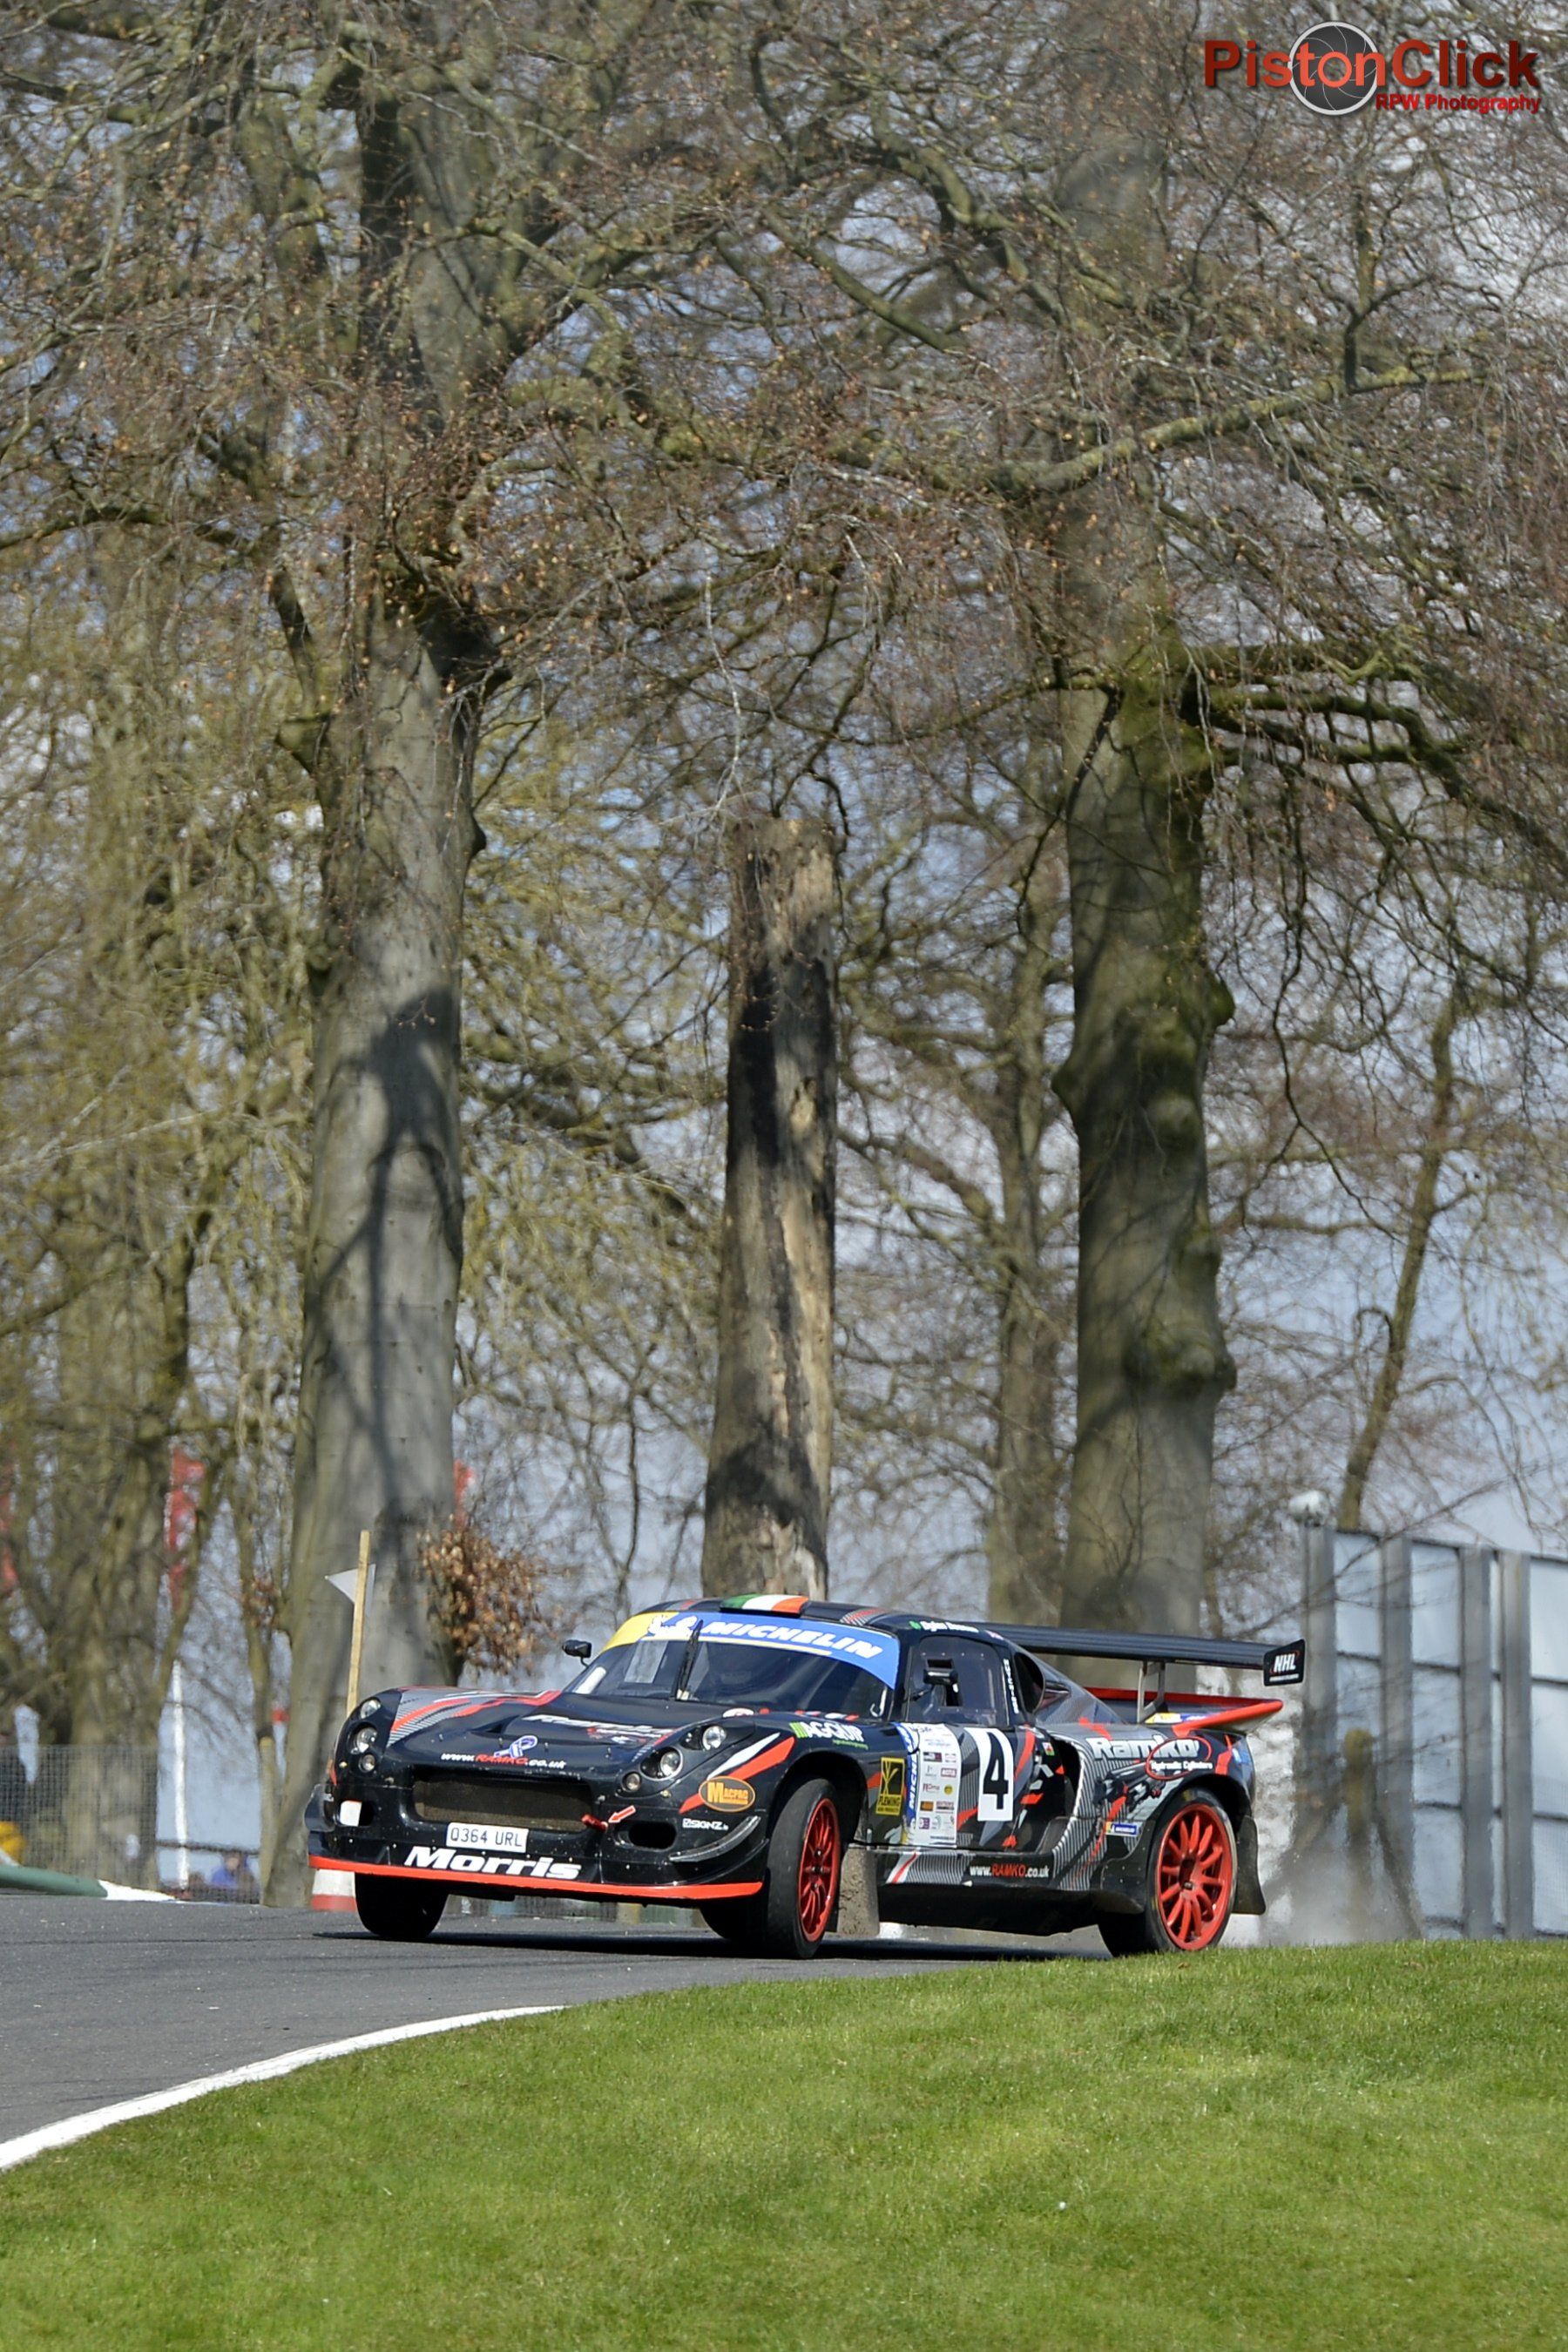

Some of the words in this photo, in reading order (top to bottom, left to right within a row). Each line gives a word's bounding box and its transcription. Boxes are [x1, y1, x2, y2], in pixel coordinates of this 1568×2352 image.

[700, 1621, 883, 1659] MICHELIN
[1274, 1653, 1296, 1673] NHL
[1086, 1735, 1200, 1759] Ramko
[983, 1732, 1009, 1810] 4
[495, 1830, 523, 1847] URL
[404, 1846, 582, 1880] Morris
[970, 1863, 1049, 1878] www.RAMKO.co.uk
